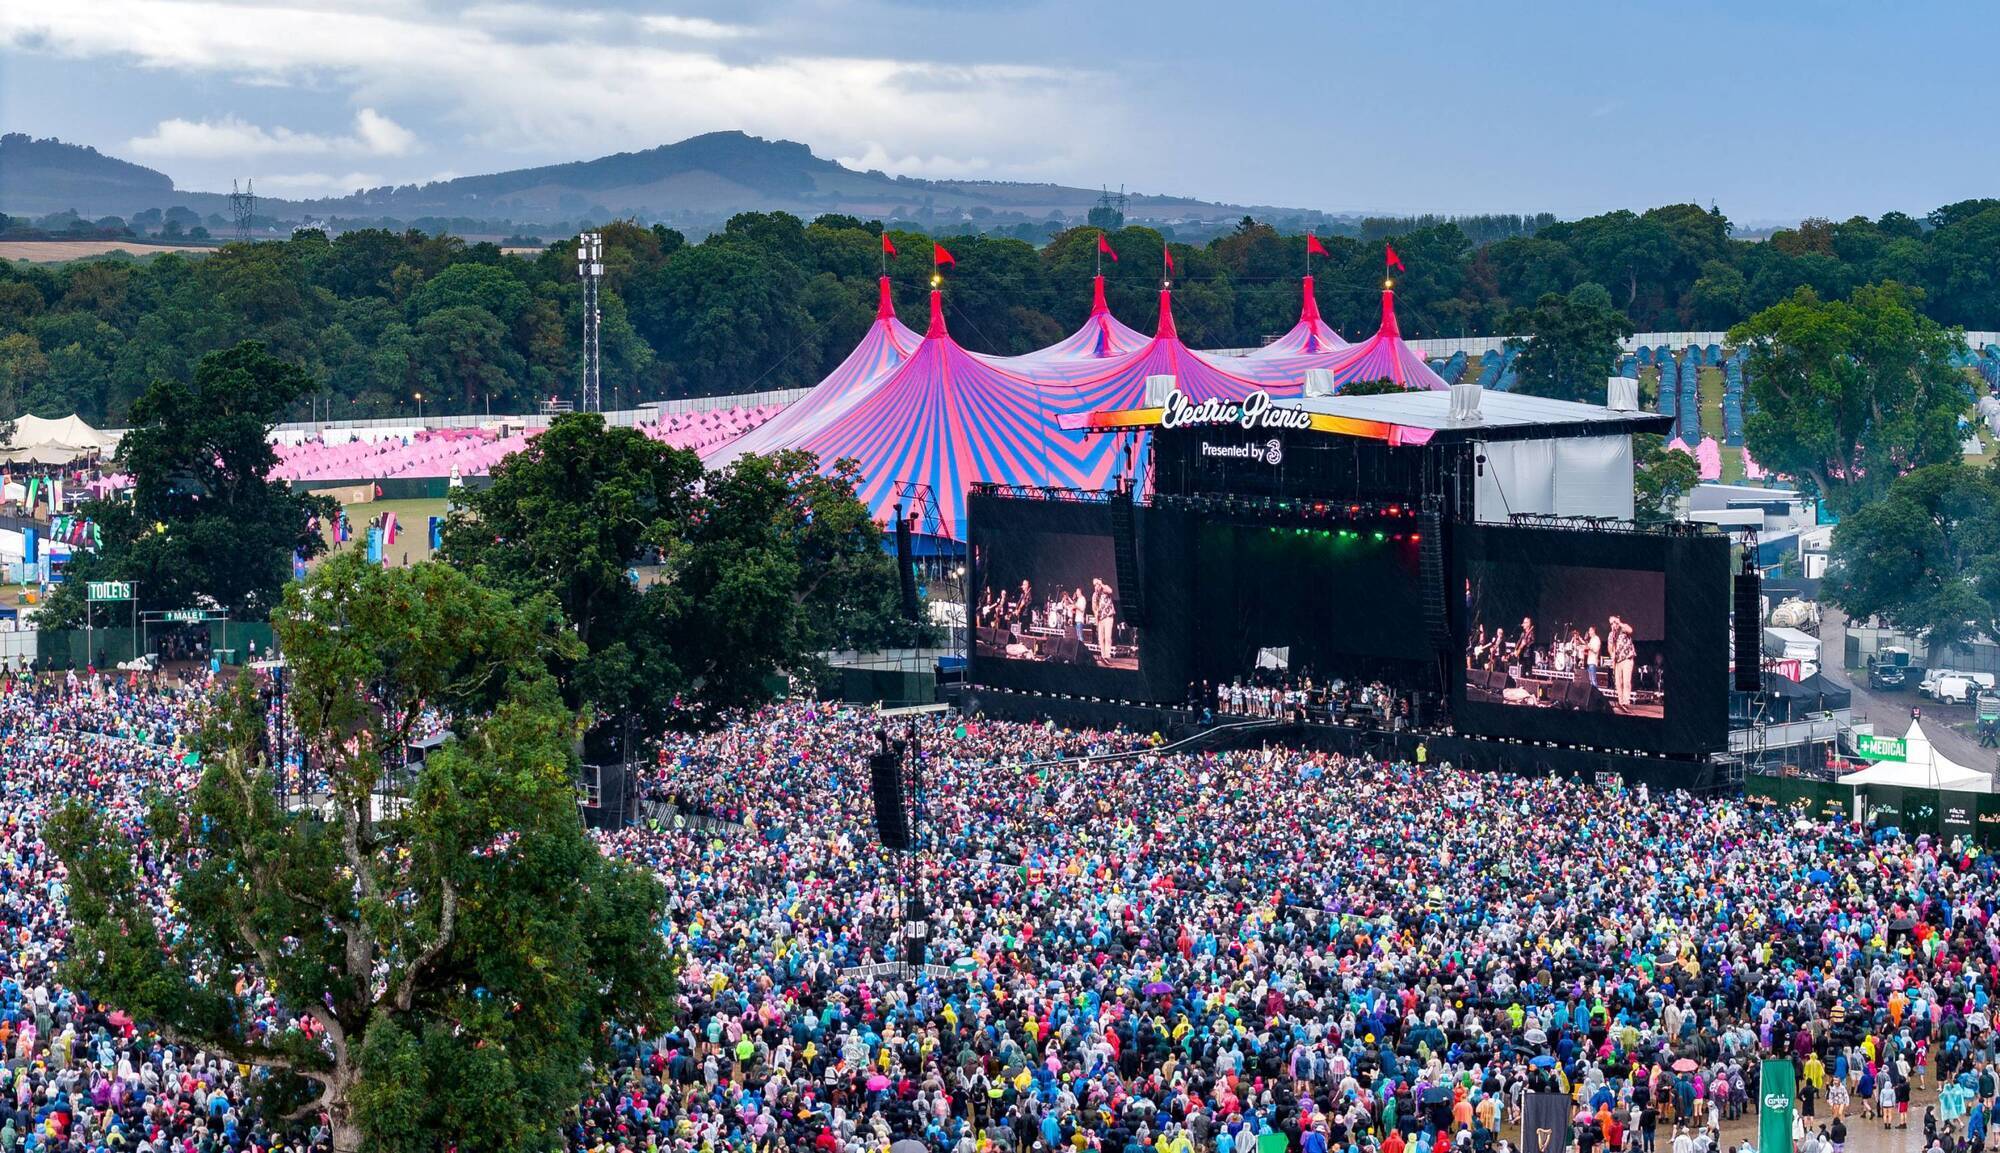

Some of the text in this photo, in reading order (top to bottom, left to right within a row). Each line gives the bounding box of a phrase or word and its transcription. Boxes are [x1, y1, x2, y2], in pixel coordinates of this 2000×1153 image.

[1161, 389, 1311, 430] Electric Picnic
[1202, 442, 1248, 457] Presented
[1251, 445, 1264, 461] by
[91, 583, 130, 599] TOILETS
[174, 612, 197, 620] MALE
[1869, 743, 1905, 757] MEDICAL
